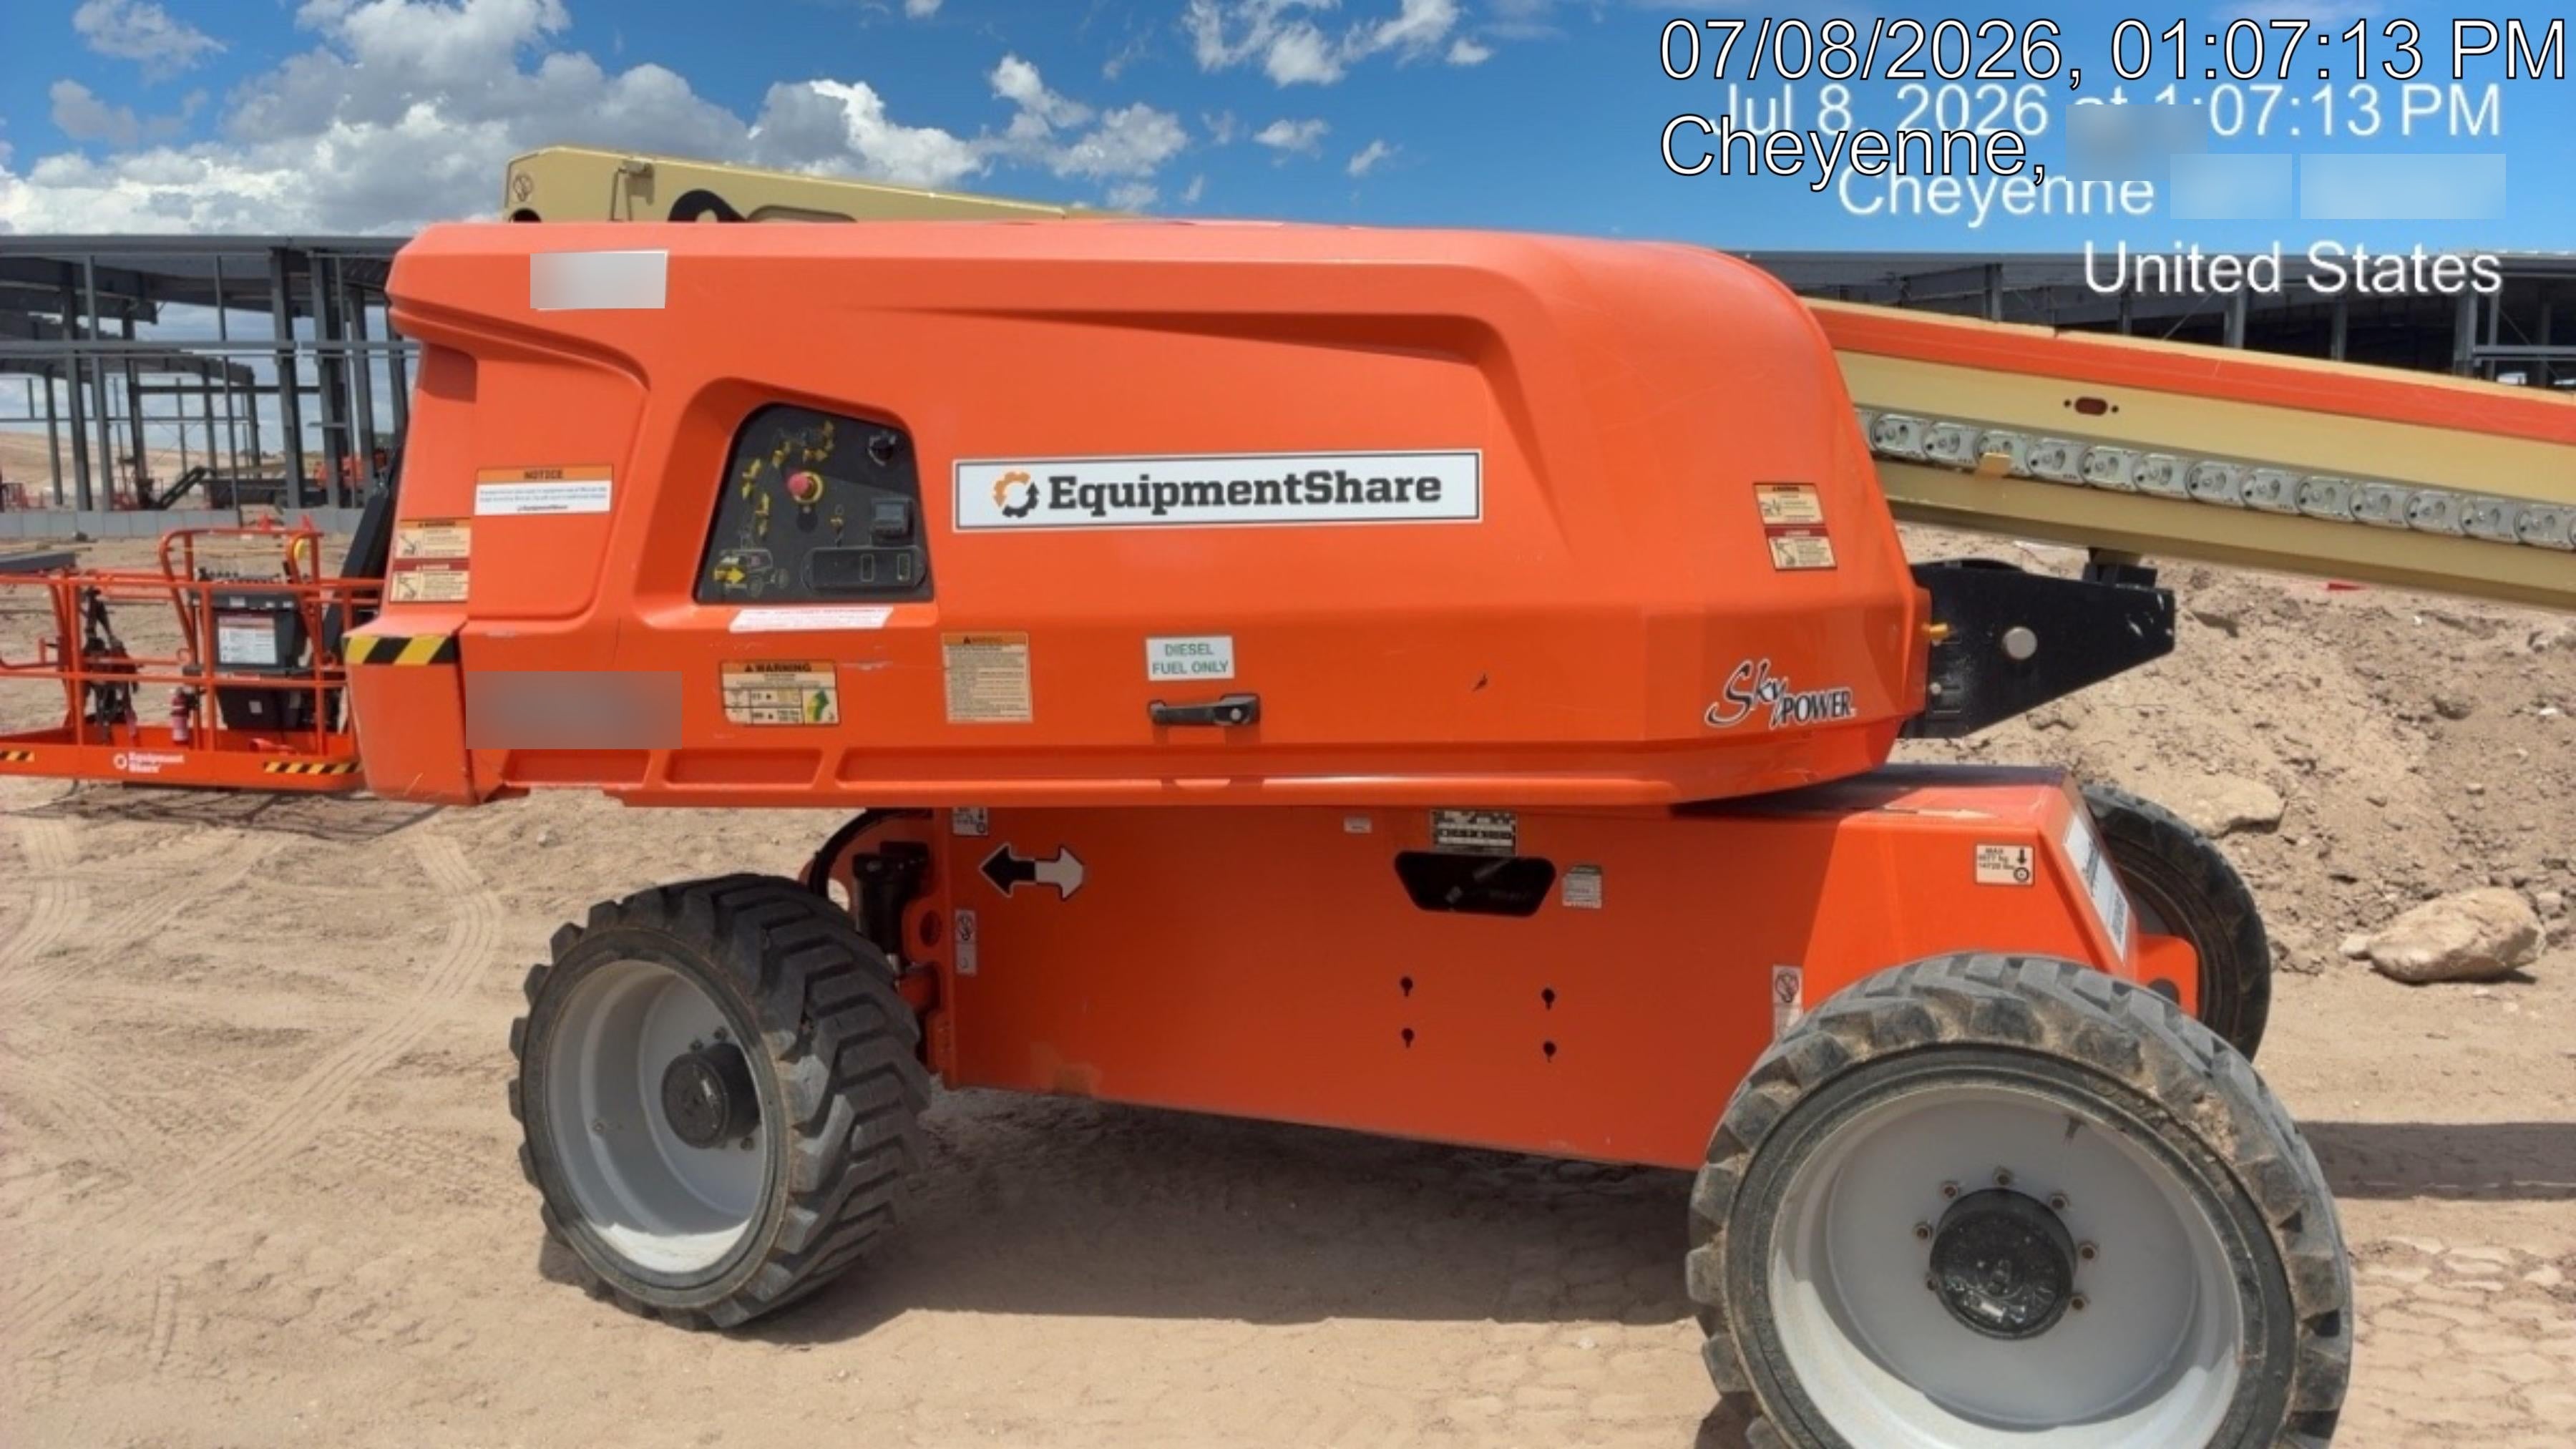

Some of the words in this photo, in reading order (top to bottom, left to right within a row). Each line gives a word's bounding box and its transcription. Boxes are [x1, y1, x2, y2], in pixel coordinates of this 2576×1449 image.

[1048, 469, 1443, 516] EquipmentShare
[1165, 643, 1214, 657] DIESEL
[1152, 662, 1187, 675] FUEL
[1191, 660, 1229, 673] ONLY
